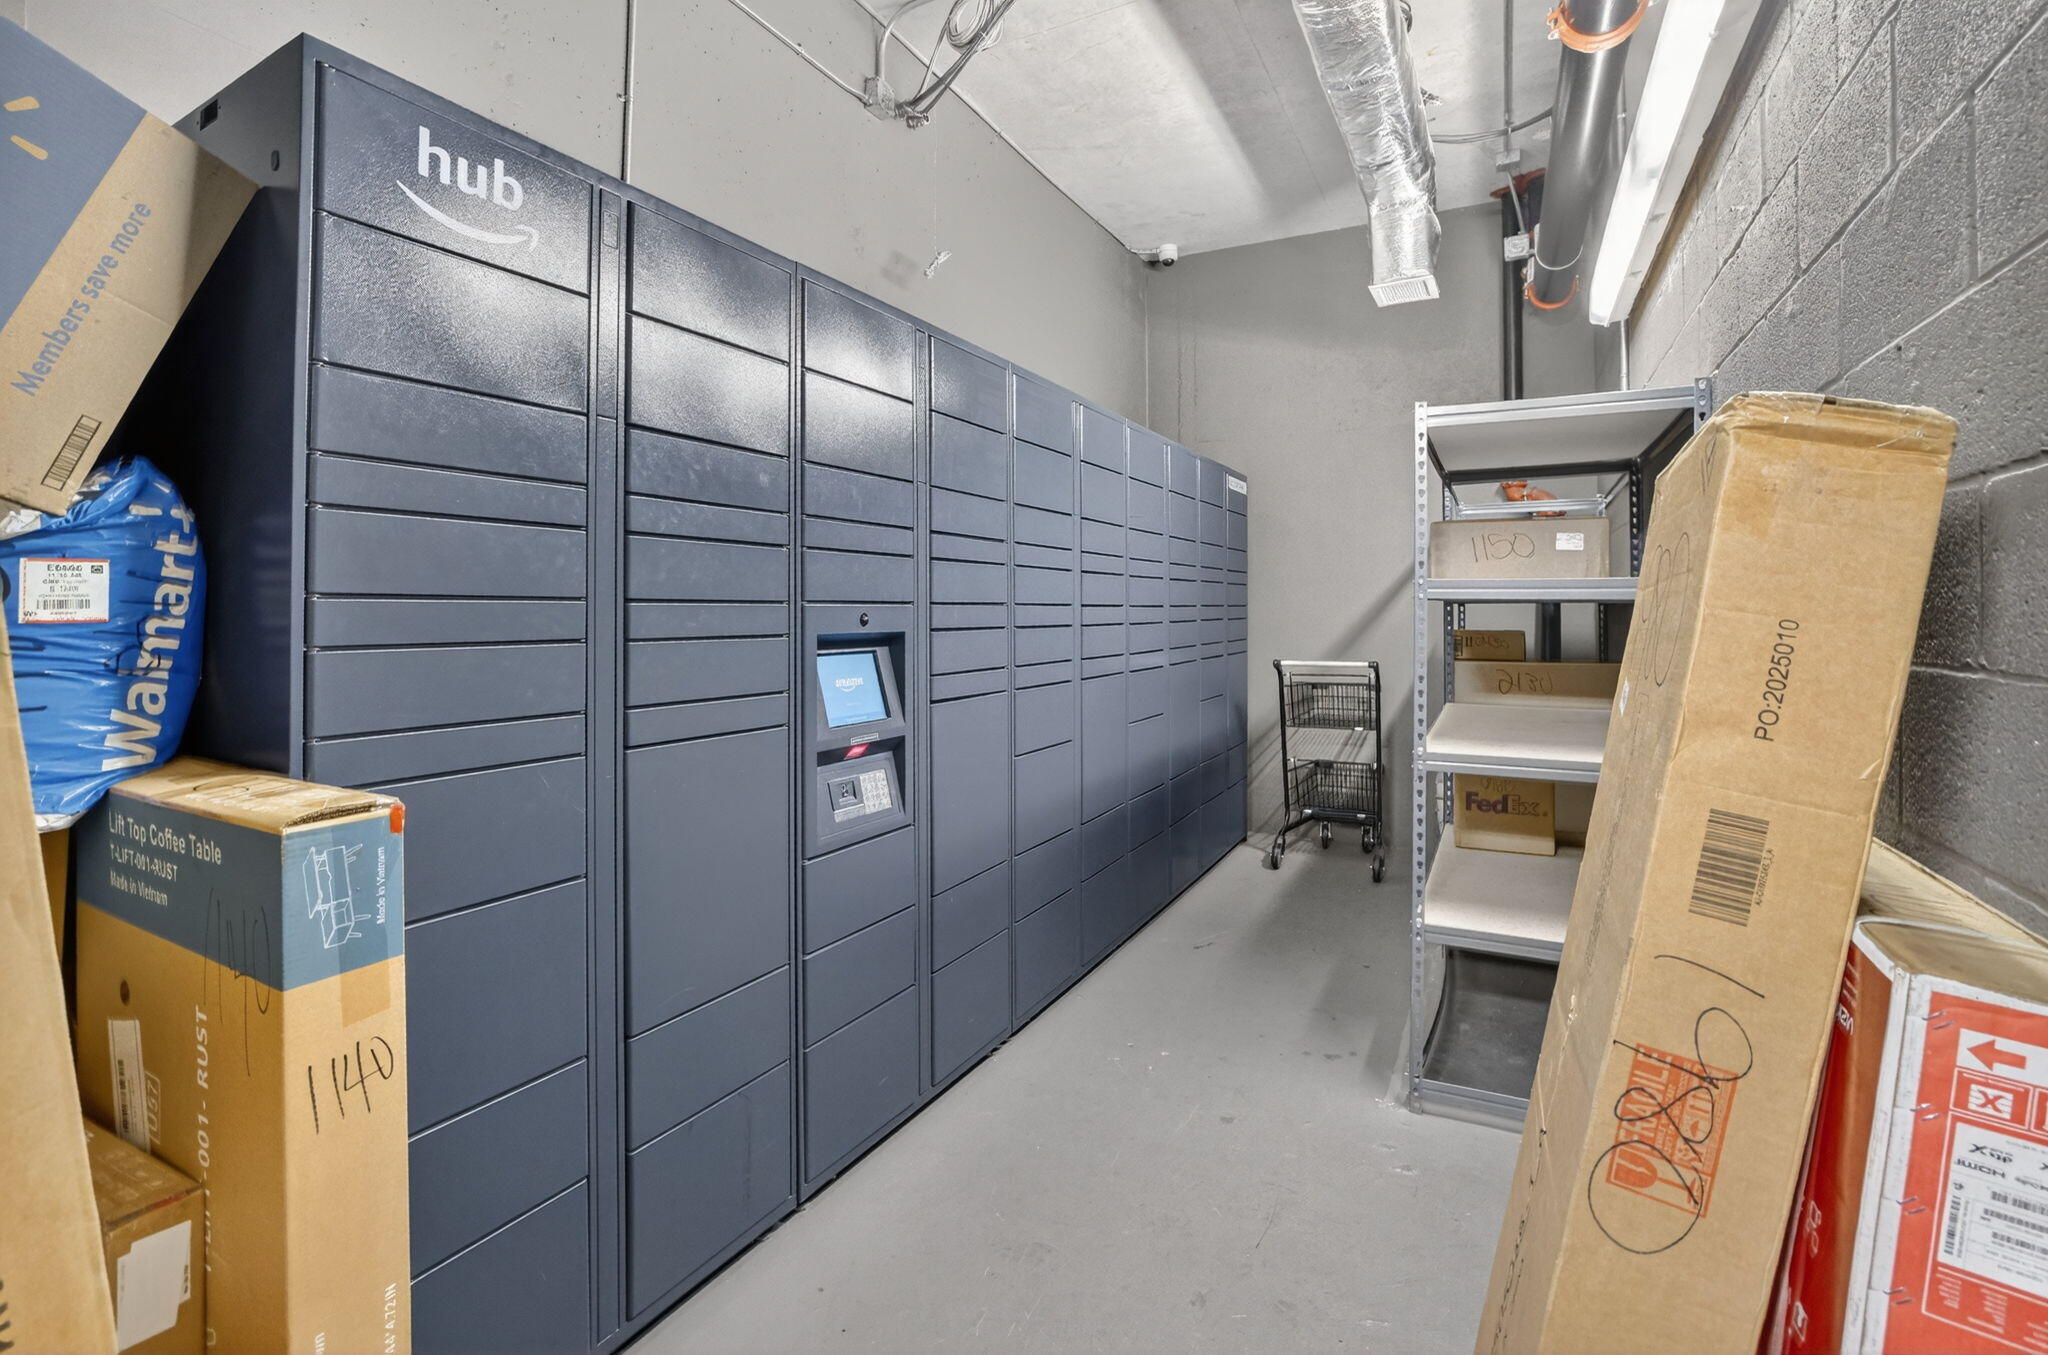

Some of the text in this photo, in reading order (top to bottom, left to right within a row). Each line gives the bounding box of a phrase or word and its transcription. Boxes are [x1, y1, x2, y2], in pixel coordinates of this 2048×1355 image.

[418, 125, 524, 211] hub
[10, 202, 151, 397] Members save more
[1471, 533, 1535, 562] 1150
[1753, 619, 1800, 742] PO:2025010
[109, 808, 222, 865] Lift Top Coffee Table
[1465, 791, 1541, 817] FedEx
[129, 876, 137, 895] in
[196, 1005, 209, 1089] RUST
[308, 1036, 394, 1135] 1140
